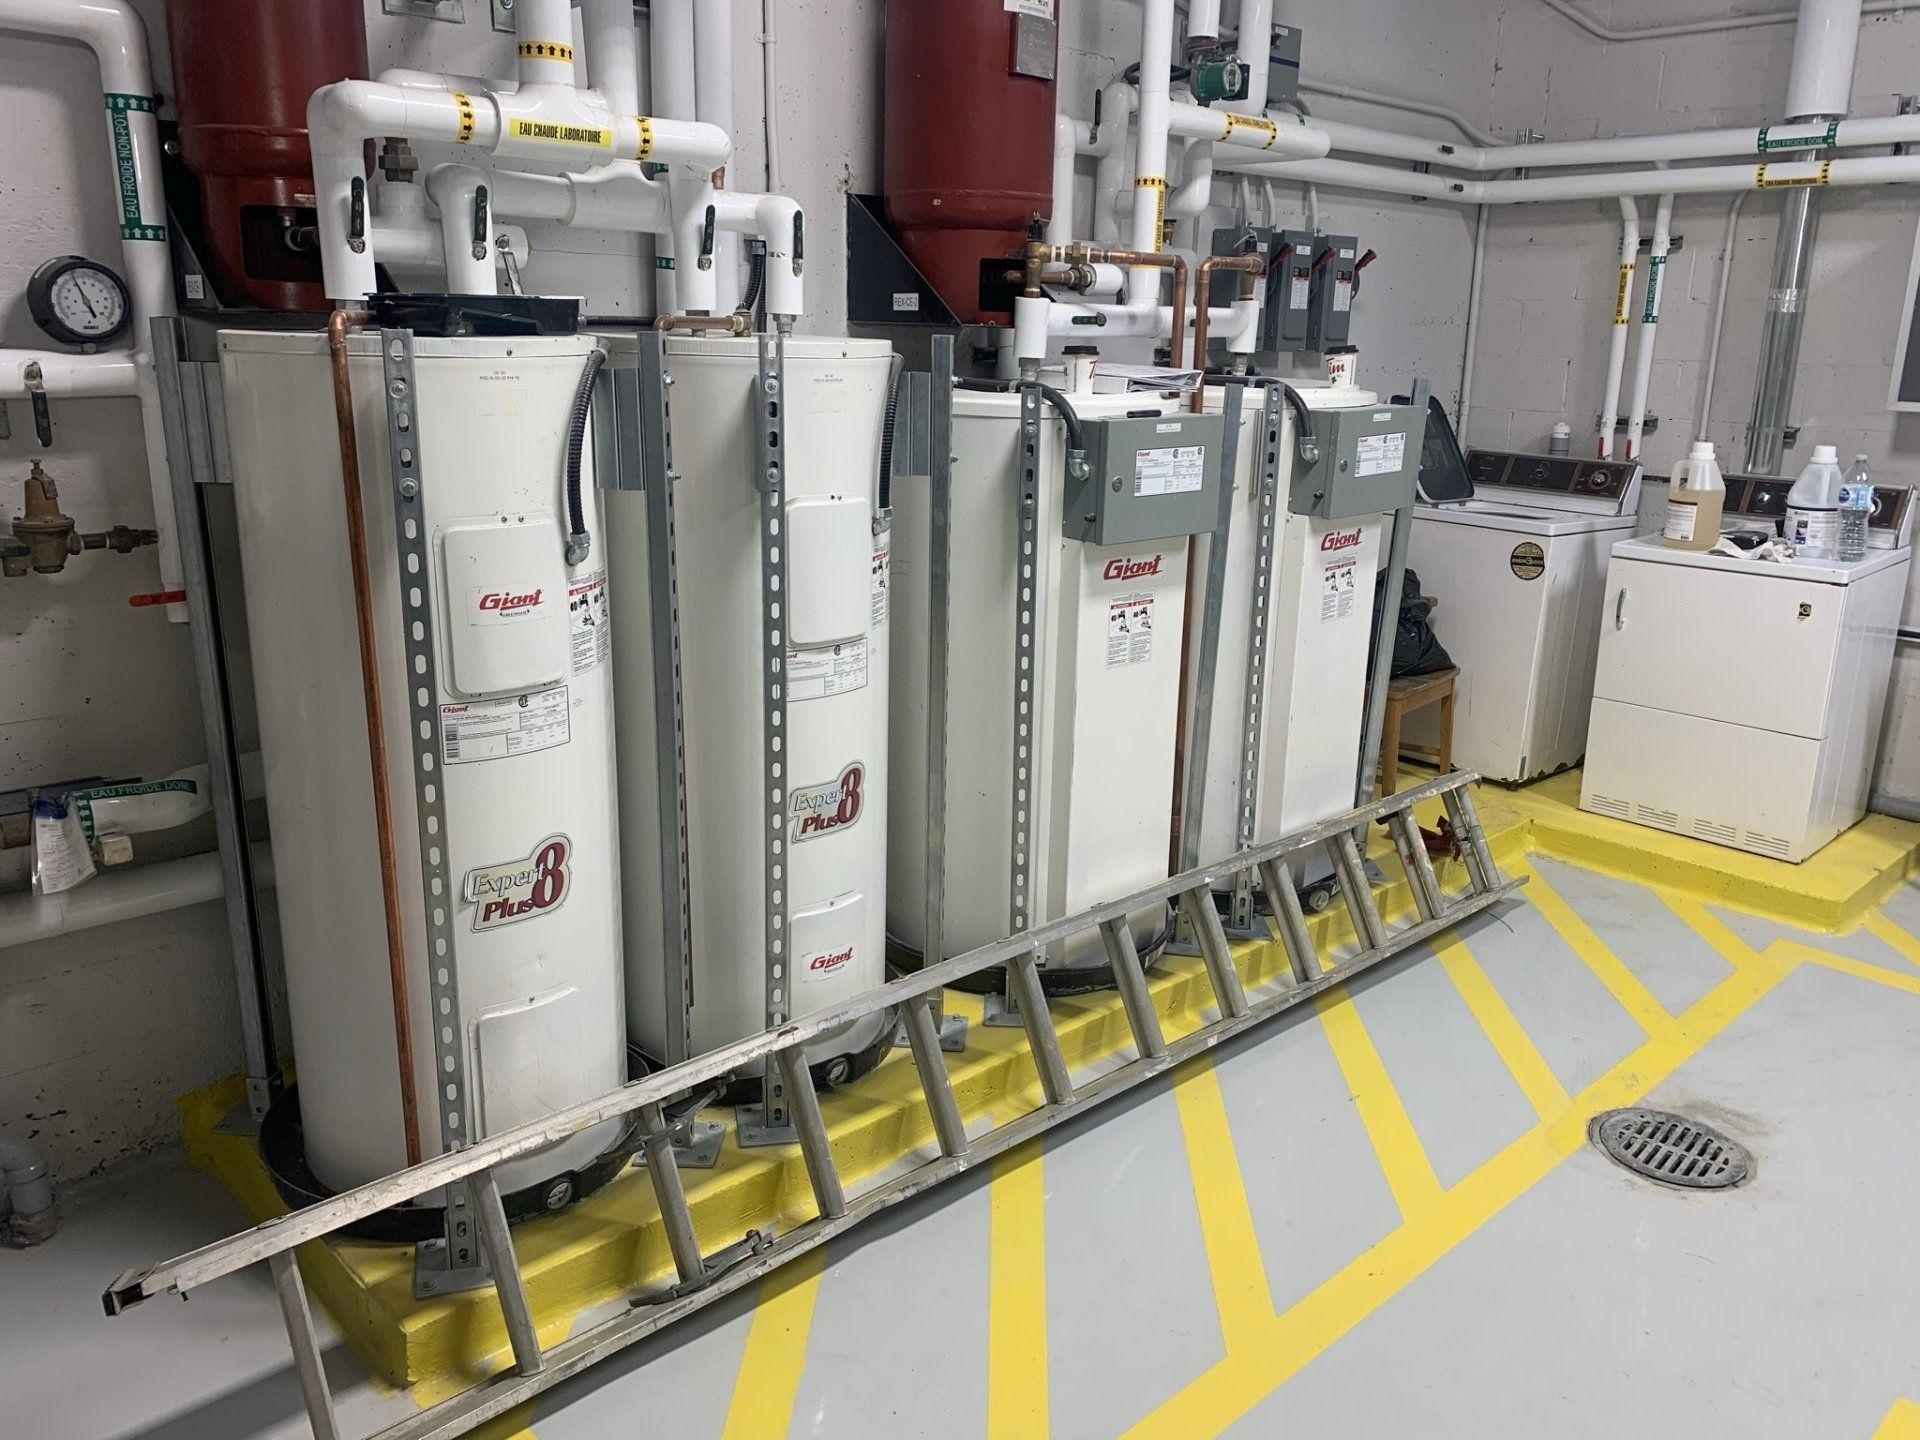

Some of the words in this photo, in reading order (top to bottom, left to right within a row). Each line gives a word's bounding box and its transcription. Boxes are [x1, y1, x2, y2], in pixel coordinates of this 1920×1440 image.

[114, 111, 131, 158] NON-POT.
[520, 121, 532, 136] EAU
[533, 124, 558, 139] CHAUDE
[560, 127, 601, 143] LABORATOIRE
[1767, 140, 1780, 148] EAU
[1782, 138, 1806, 147] FROIDE
[120, 159, 136, 196] FROIDE
[125, 197, 138, 218] EAU
[1648, 281, 1656, 299] FROIDE
[1645, 301, 1653, 314] EAU
[1321, 528, 1363, 551] Giant
[1103, 554, 1164, 580] Giant
[479, 589, 544, 611] Giant
[442, 705, 469, 713] Giant
[91, 788, 115, 799] EAU
[118, 781, 161, 796] FROIDE
[794, 786, 847, 813] Expert
[837, 767, 861, 824] 8
[801, 813, 839, 834] Plus
[473, 862, 545, 897] Expert
[531, 842, 565, 908] 8
[482, 897, 534, 922] Plus
[810, 947, 855, 970] Giant
